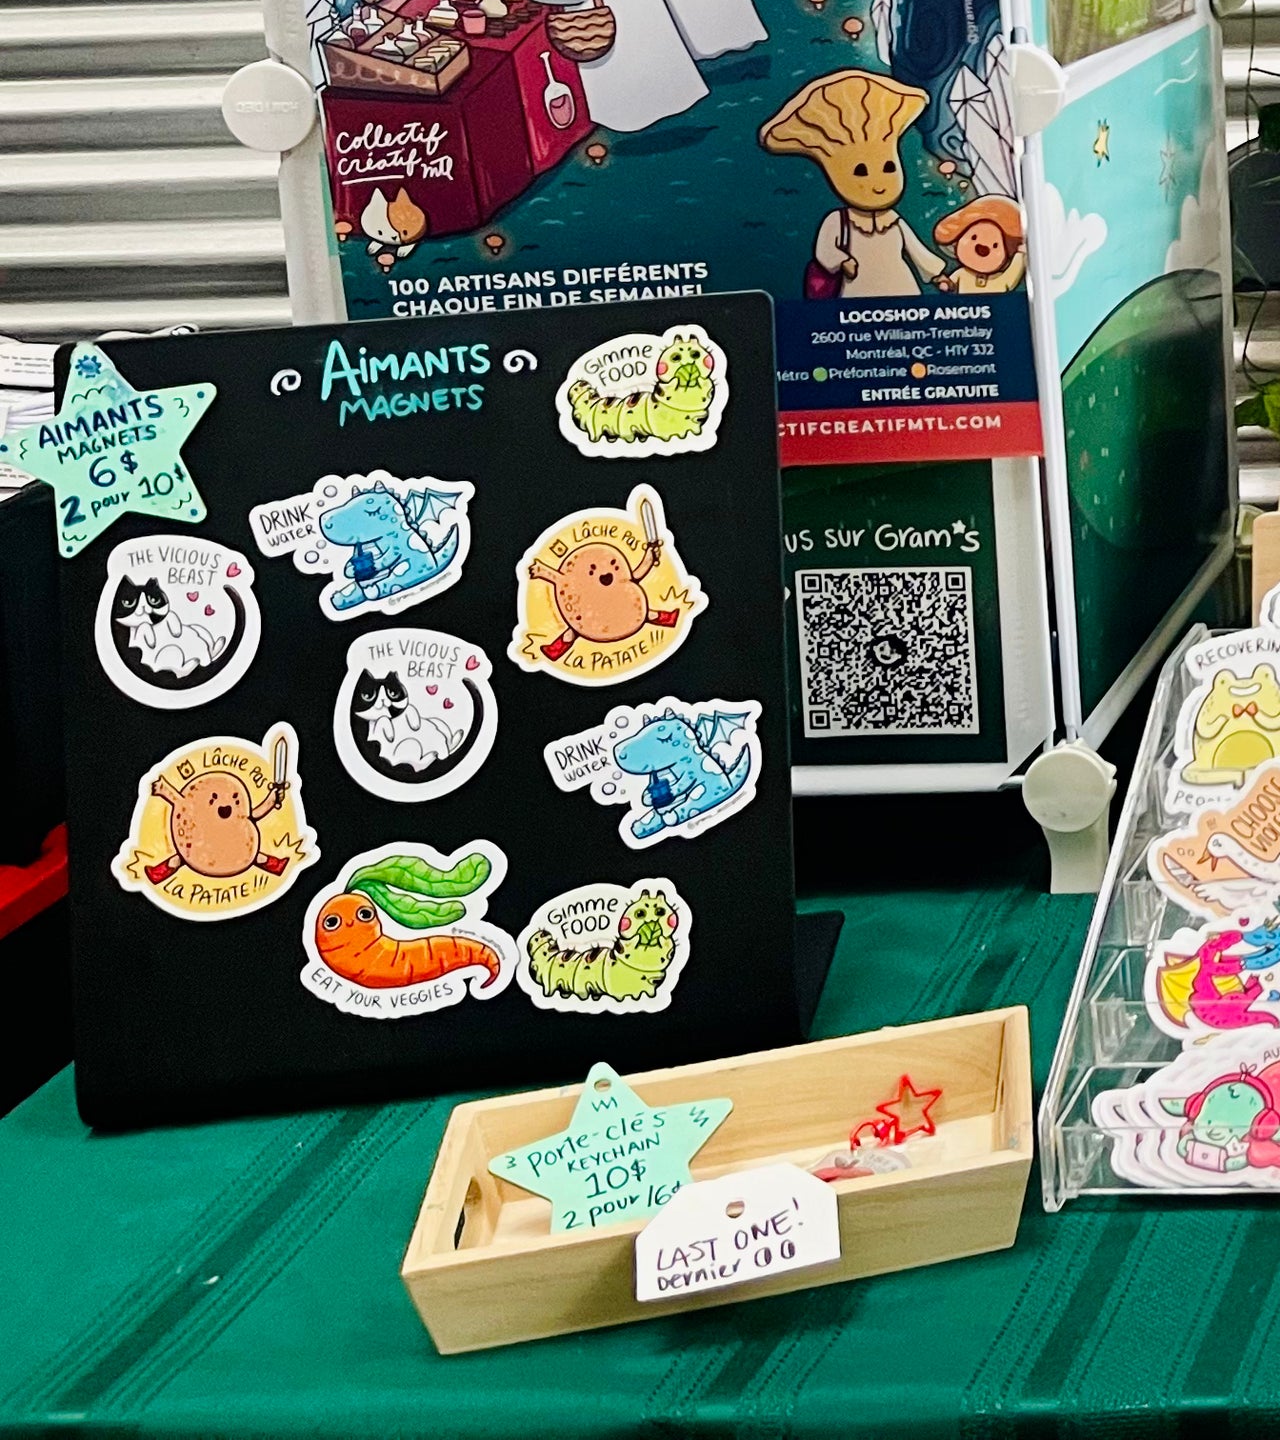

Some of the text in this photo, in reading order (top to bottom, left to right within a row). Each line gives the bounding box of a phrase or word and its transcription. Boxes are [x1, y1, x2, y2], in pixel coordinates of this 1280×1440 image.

[389, 261, 709, 297] 100 ARTISANS DIFFÉRENTS
[839, 304, 992, 325] LOCOSHOP ANGUS
[811, 324, 993, 344] 2600 rue William-Tremblay
[911, 345, 933, 359] QC
[828, 361, 996, 381] Préfontaine Rosemont
[338, 385, 485, 424] MAGNETS
[861, 382, 999, 402] ENTRÉE GRATUITE
[38, 394, 165, 449] AIMANTS
[57, 425, 157, 464] MAGNETS
[60, 463, 185, 528] 2 pour 10$
[260, 504, 313, 535] DRINK
[825, 527, 865, 550] sur
[564, 651, 586, 670] La
[310, 967, 455, 1008] EAT YOUR VEGGIES
[527, 1108, 666, 1178] porte-clés
[567, 1132, 661, 1174] KEYCHAIN
[584, 1159, 646, 1199] 10$
[563, 1193, 640, 1230] 2 pour
[656, 1197, 805, 1271] LAST ONE!
